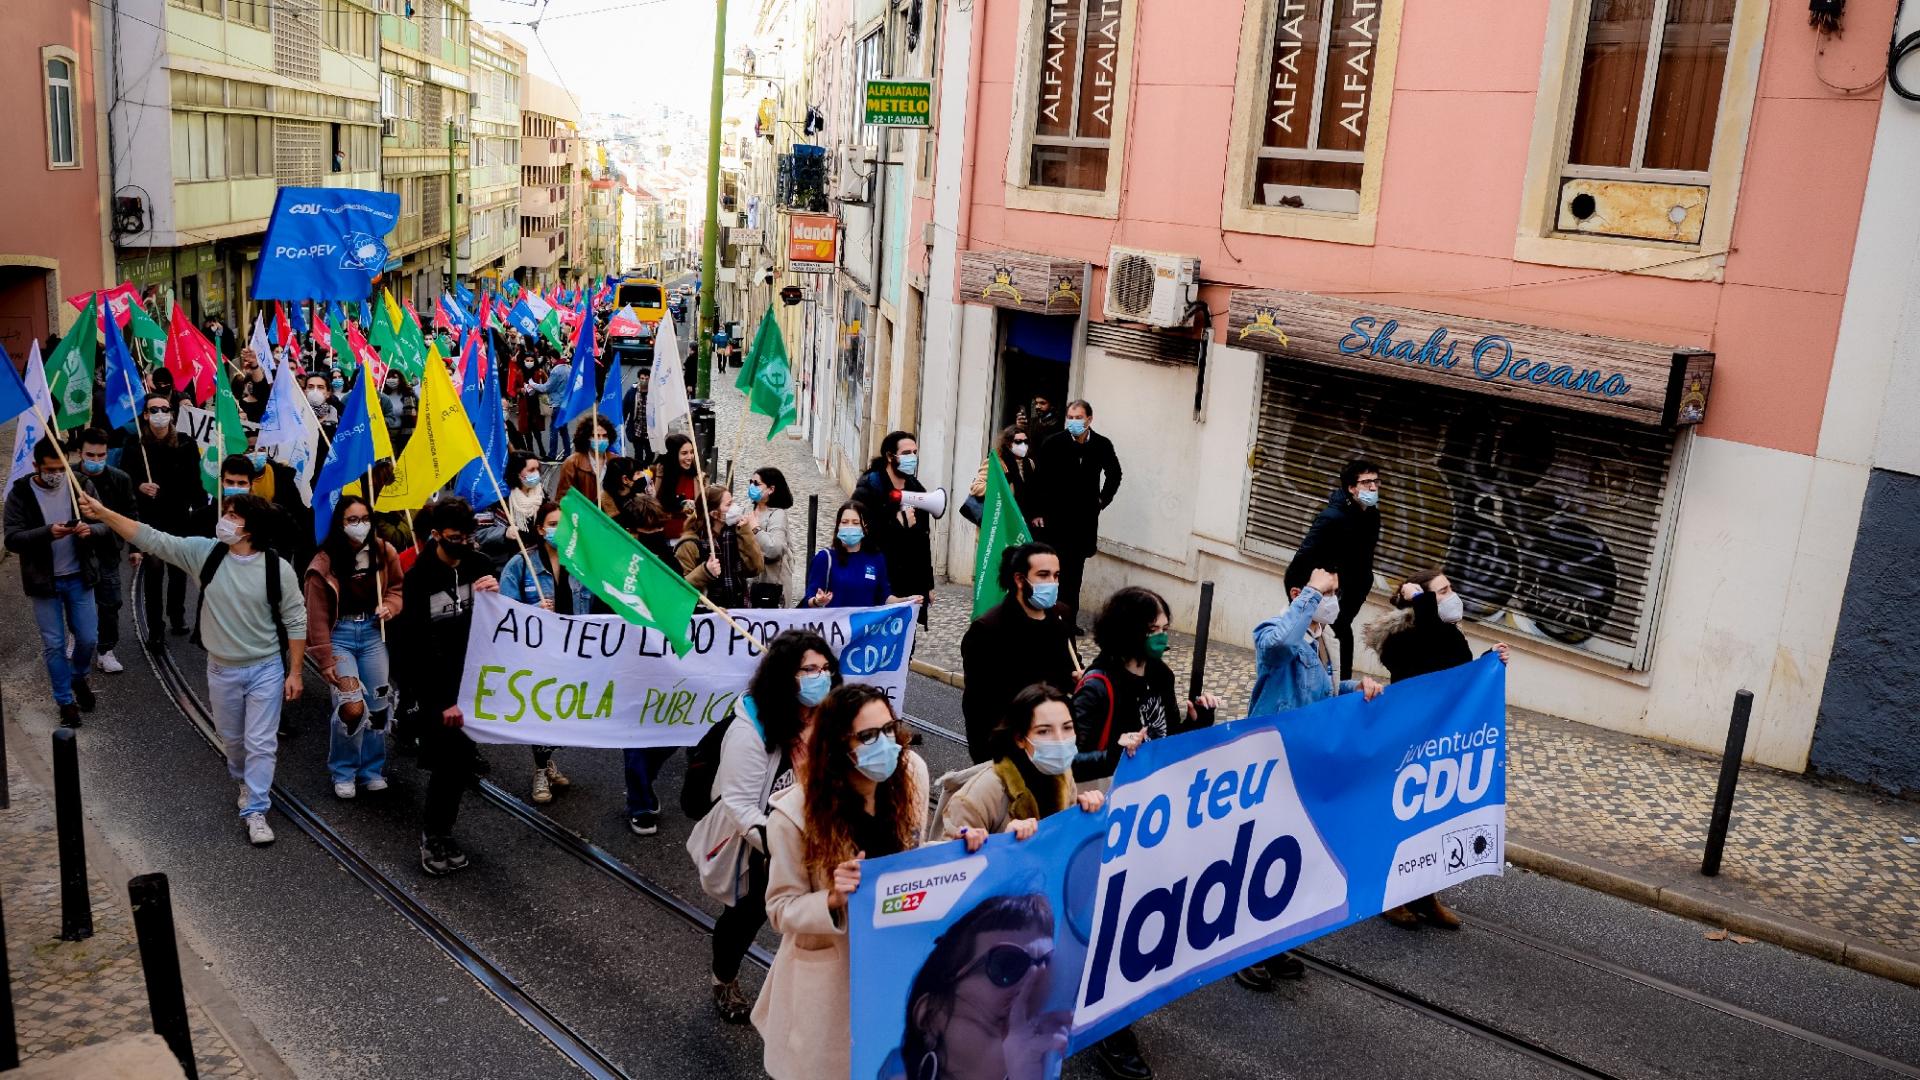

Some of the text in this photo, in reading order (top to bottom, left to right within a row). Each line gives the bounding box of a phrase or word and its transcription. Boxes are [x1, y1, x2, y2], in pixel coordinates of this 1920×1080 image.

[1042, 0, 1068, 122] ALFAIAT
[1092, 0, 1119, 125] ALFAIAT
[1271, 0, 1305, 133] ALFAIAT
[1339, 0, 1376, 136] ALFAIAT
[867, 84, 929, 97] ALFAIATARIA
[867, 98, 929, 113] METELO
[894, 115, 925, 124] ANDAR
[288, 203, 322, 215] CDU
[275, 244, 337, 260] PCP-PEV
[1338, 316, 1632, 398] Shahi Oceano
[493, 608, 543, 649] AO
[559, 616, 626, 659] TEU
[846, 643, 897, 673] CDU
[474, 665, 615, 723] ESCOLA
[1394, 722, 1499, 772] juventude
[1392, 748, 1496, 821] CDU
[1101, 759, 1279, 864] ao teu
[886, 871, 967, 896] LEGISLATIVAS
[1398, 852, 1437, 877] PCP-PEV
[884, 895, 920, 913] 2022
[1084, 819, 1302, 1009] lado
